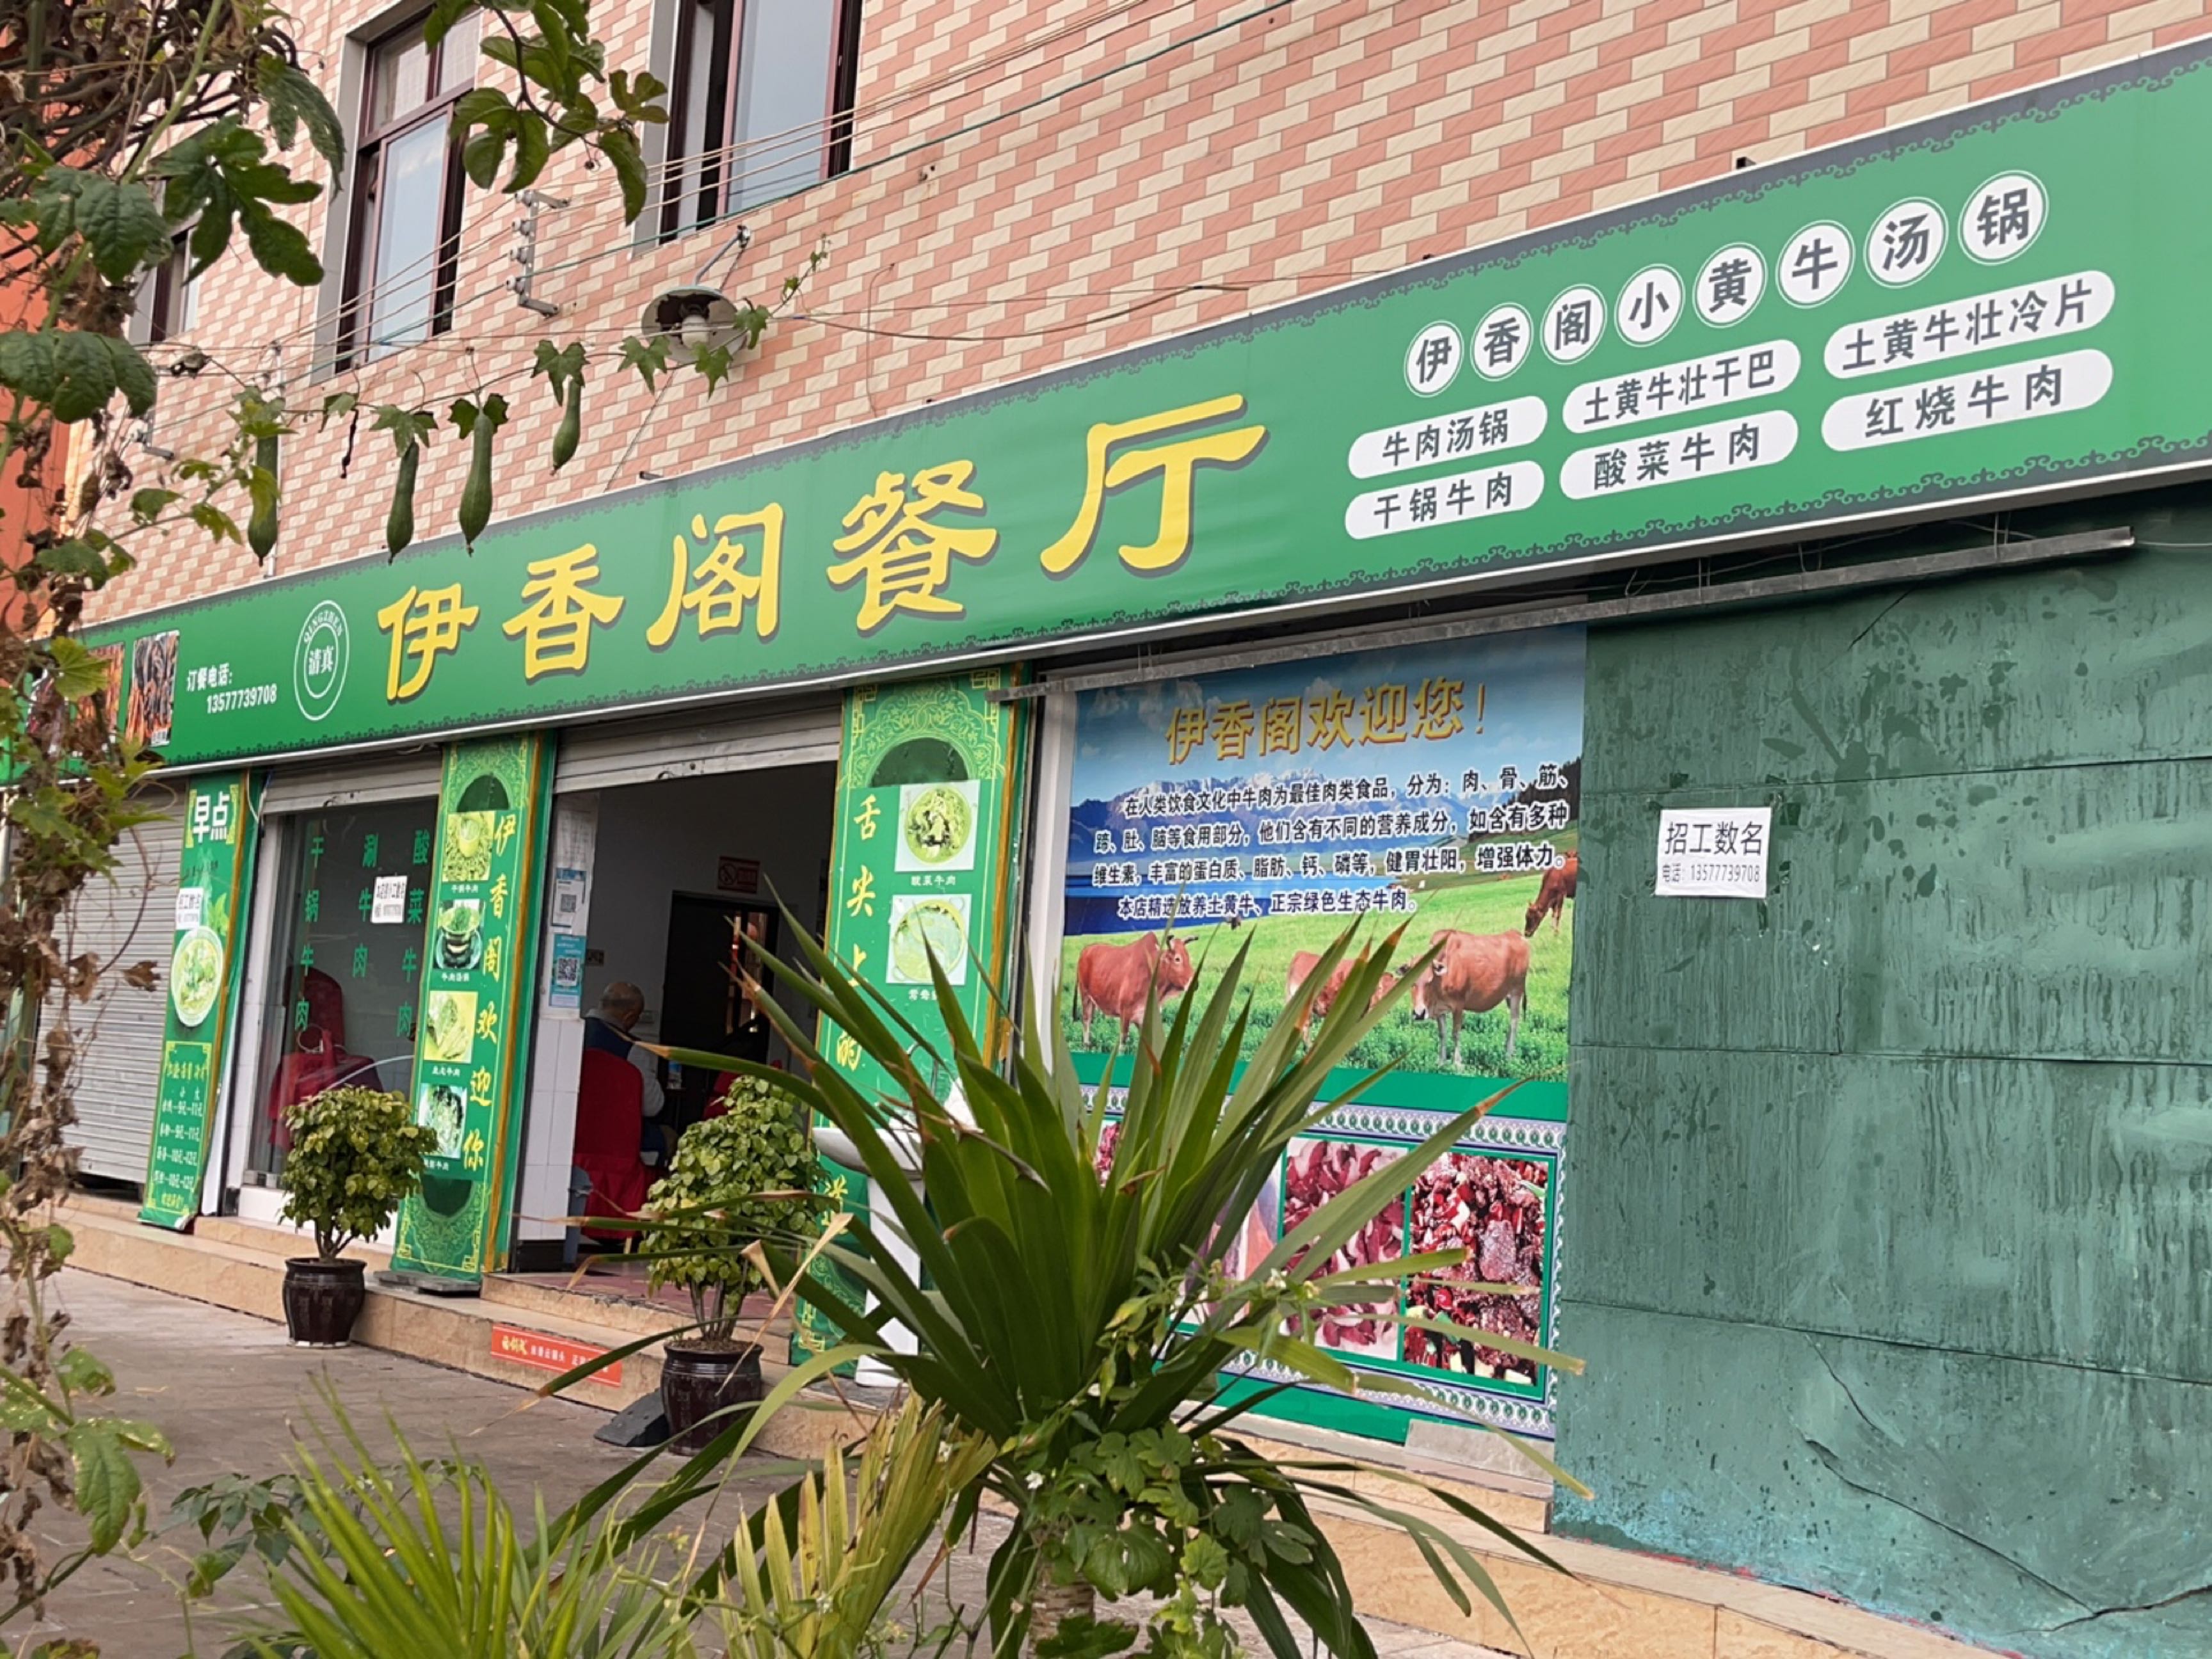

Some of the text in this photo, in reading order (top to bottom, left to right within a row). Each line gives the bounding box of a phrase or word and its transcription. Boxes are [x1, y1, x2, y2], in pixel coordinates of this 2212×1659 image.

[1416, 188, 2029, 383] 伊香阁小黄牛汤锅
[1842, 279, 2093, 371] 土黄牛壮冷片
[1584, 349, 1775, 425] 土黄牛壮干巴
[1864, 364, 2061, 438] 红烧牛肉
[1382, 408, 1508, 467] 牛肉汤锅
[1594, 422, 1759, 490] 酸菜牛肉
[1374, 471, 1513, 529] 干锅牛肉
[378, 393, 1267, 701] 伊香阁餐厅
[308, 645, 335, 677] 清真
[207, 683, 277, 714] 13577739708
[193, 790, 231, 843] 早点
[1664, 820, 1763, 856] 招工数名
[1691, 864, 1760, 882] 13577739708
[294, 837, 325, 1032] 干锅牛肉
[463, 813, 517, 1172] 伊香阁欢迎你
